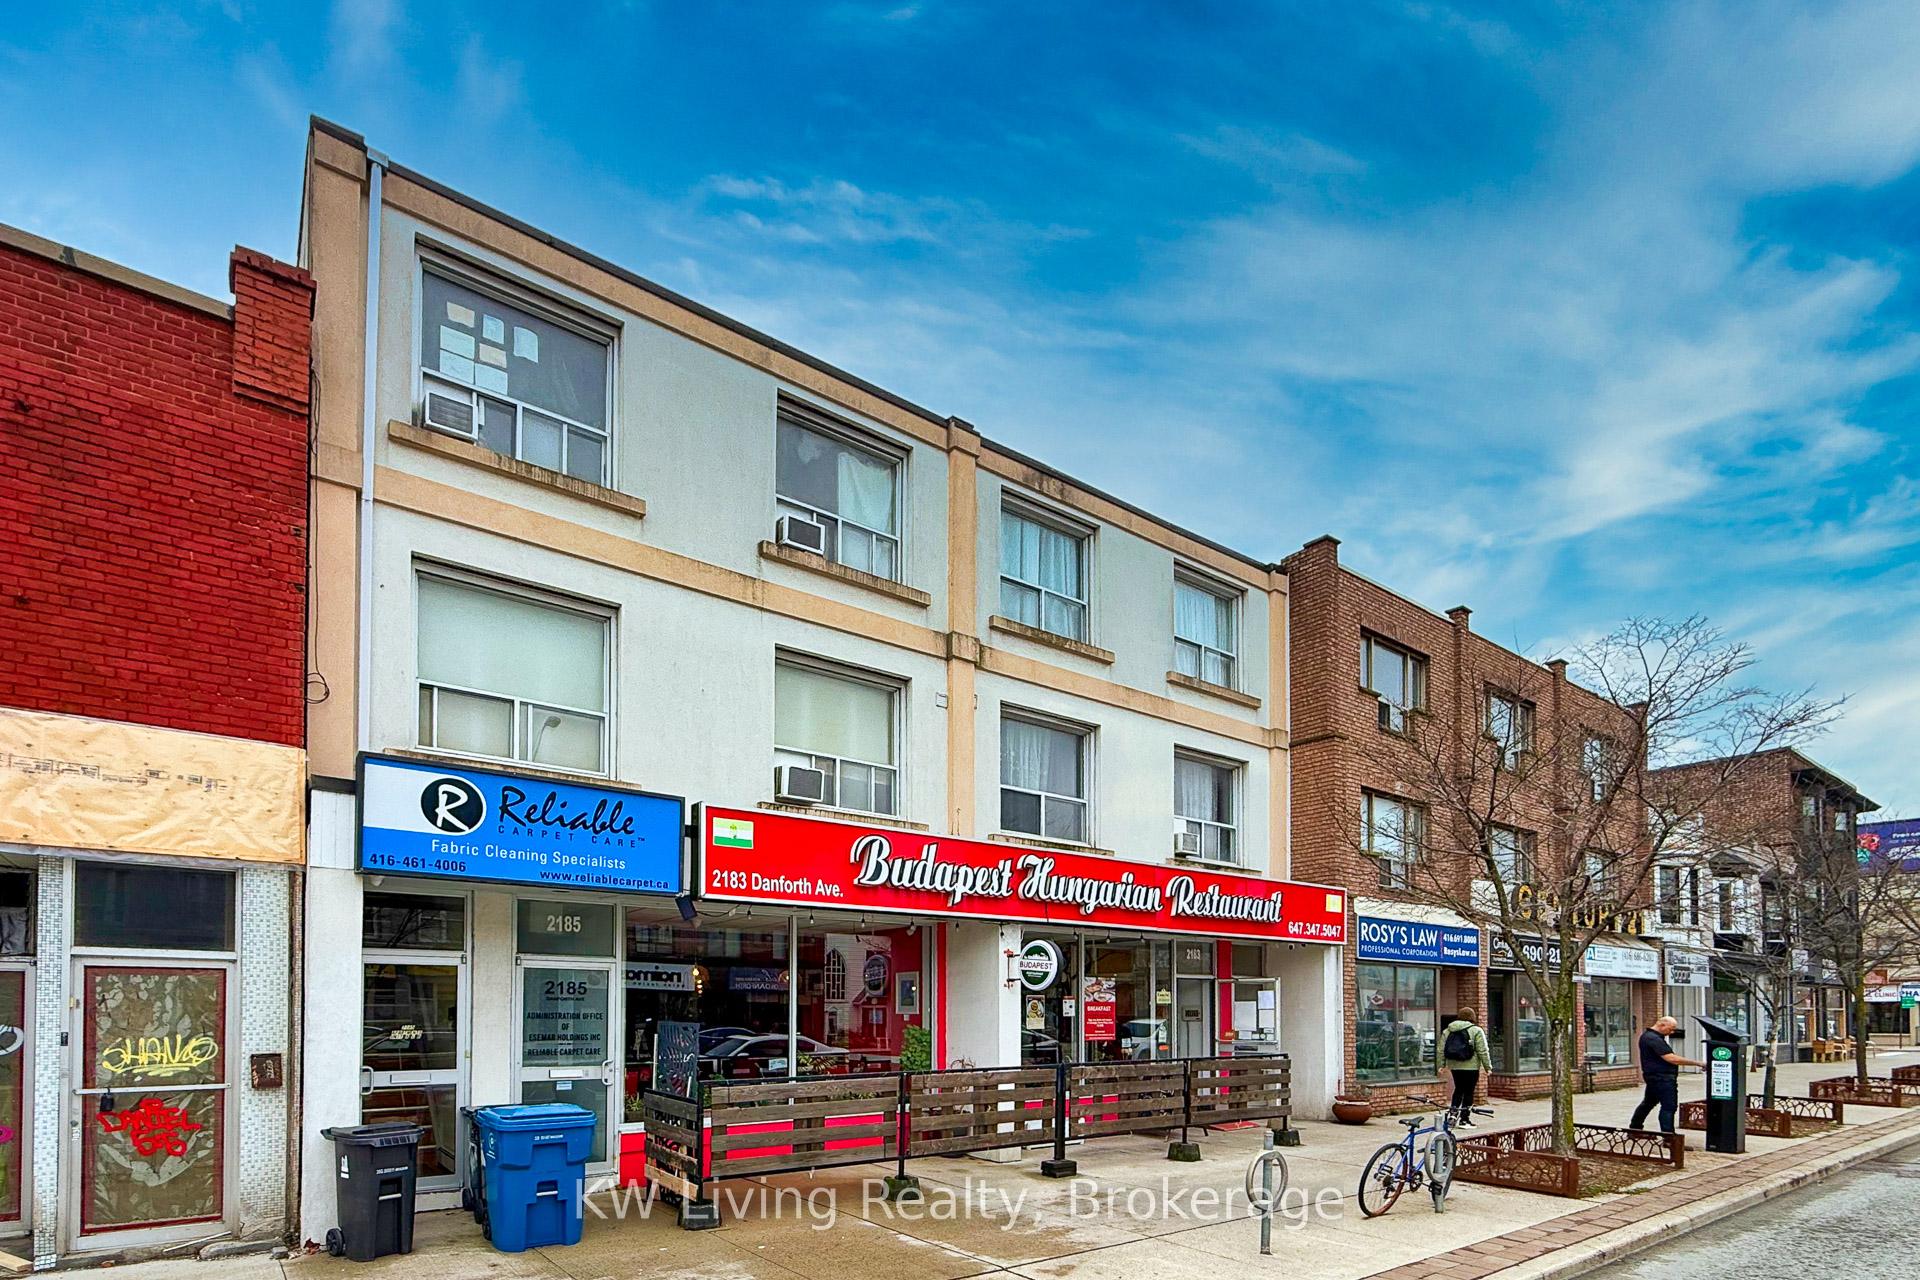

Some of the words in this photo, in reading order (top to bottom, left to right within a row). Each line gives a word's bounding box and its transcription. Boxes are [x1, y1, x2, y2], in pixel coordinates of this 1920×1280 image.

[499, 785, 635, 835] Reliable
[498, 825, 575, 842] CARPET
[591, 835, 636, 848] CARE
[370, 853, 467, 873] 416-461-4006
[431, 839, 479, 856] Fabric
[485, 844, 548, 865] Cleaning
[552, 851, 626, 870] Specialists
[540, 870, 669, 890] www.reliablecarpet.ca
[712, 869, 747, 890] 2183
[751, 872, 812, 895] Danforth
[815, 878, 844, 898] Ave.
[849, 834, 1013, 907] Budapest
[1016, 853, 1164, 916] Hungarian
[1164, 875, 1283, 924] Restaurant
[547, 915, 582, 933] 2185
[1288, 921, 1342, 938] 647.347.5047
[1360, 922, 1408, 945] ROSY'S
[1411, 927, 1438, 947] LAW
[1360, 944, 1401, 955] PROFESSIONAL
[1401, 947, 1438, 957] CORPORATION
[1019, 960, 1053, 970] BUDAPEST
[545, 981, 588, 996] 2185
[527, 1012, 581, 1020] ADMINISTRATION
[582, 1012, 604, 1021] OFFICE
[561, 1023, 570, 1031] OF
[557, 1033, 589, 1042] HOLDINGS
[590, 1033, 601, 1041] INC
[527, 1048, 558, 1057] RELIABLE
[559, 1048, 584, 1057] CARPET
[585, 1048, 602, 1056] CARE
